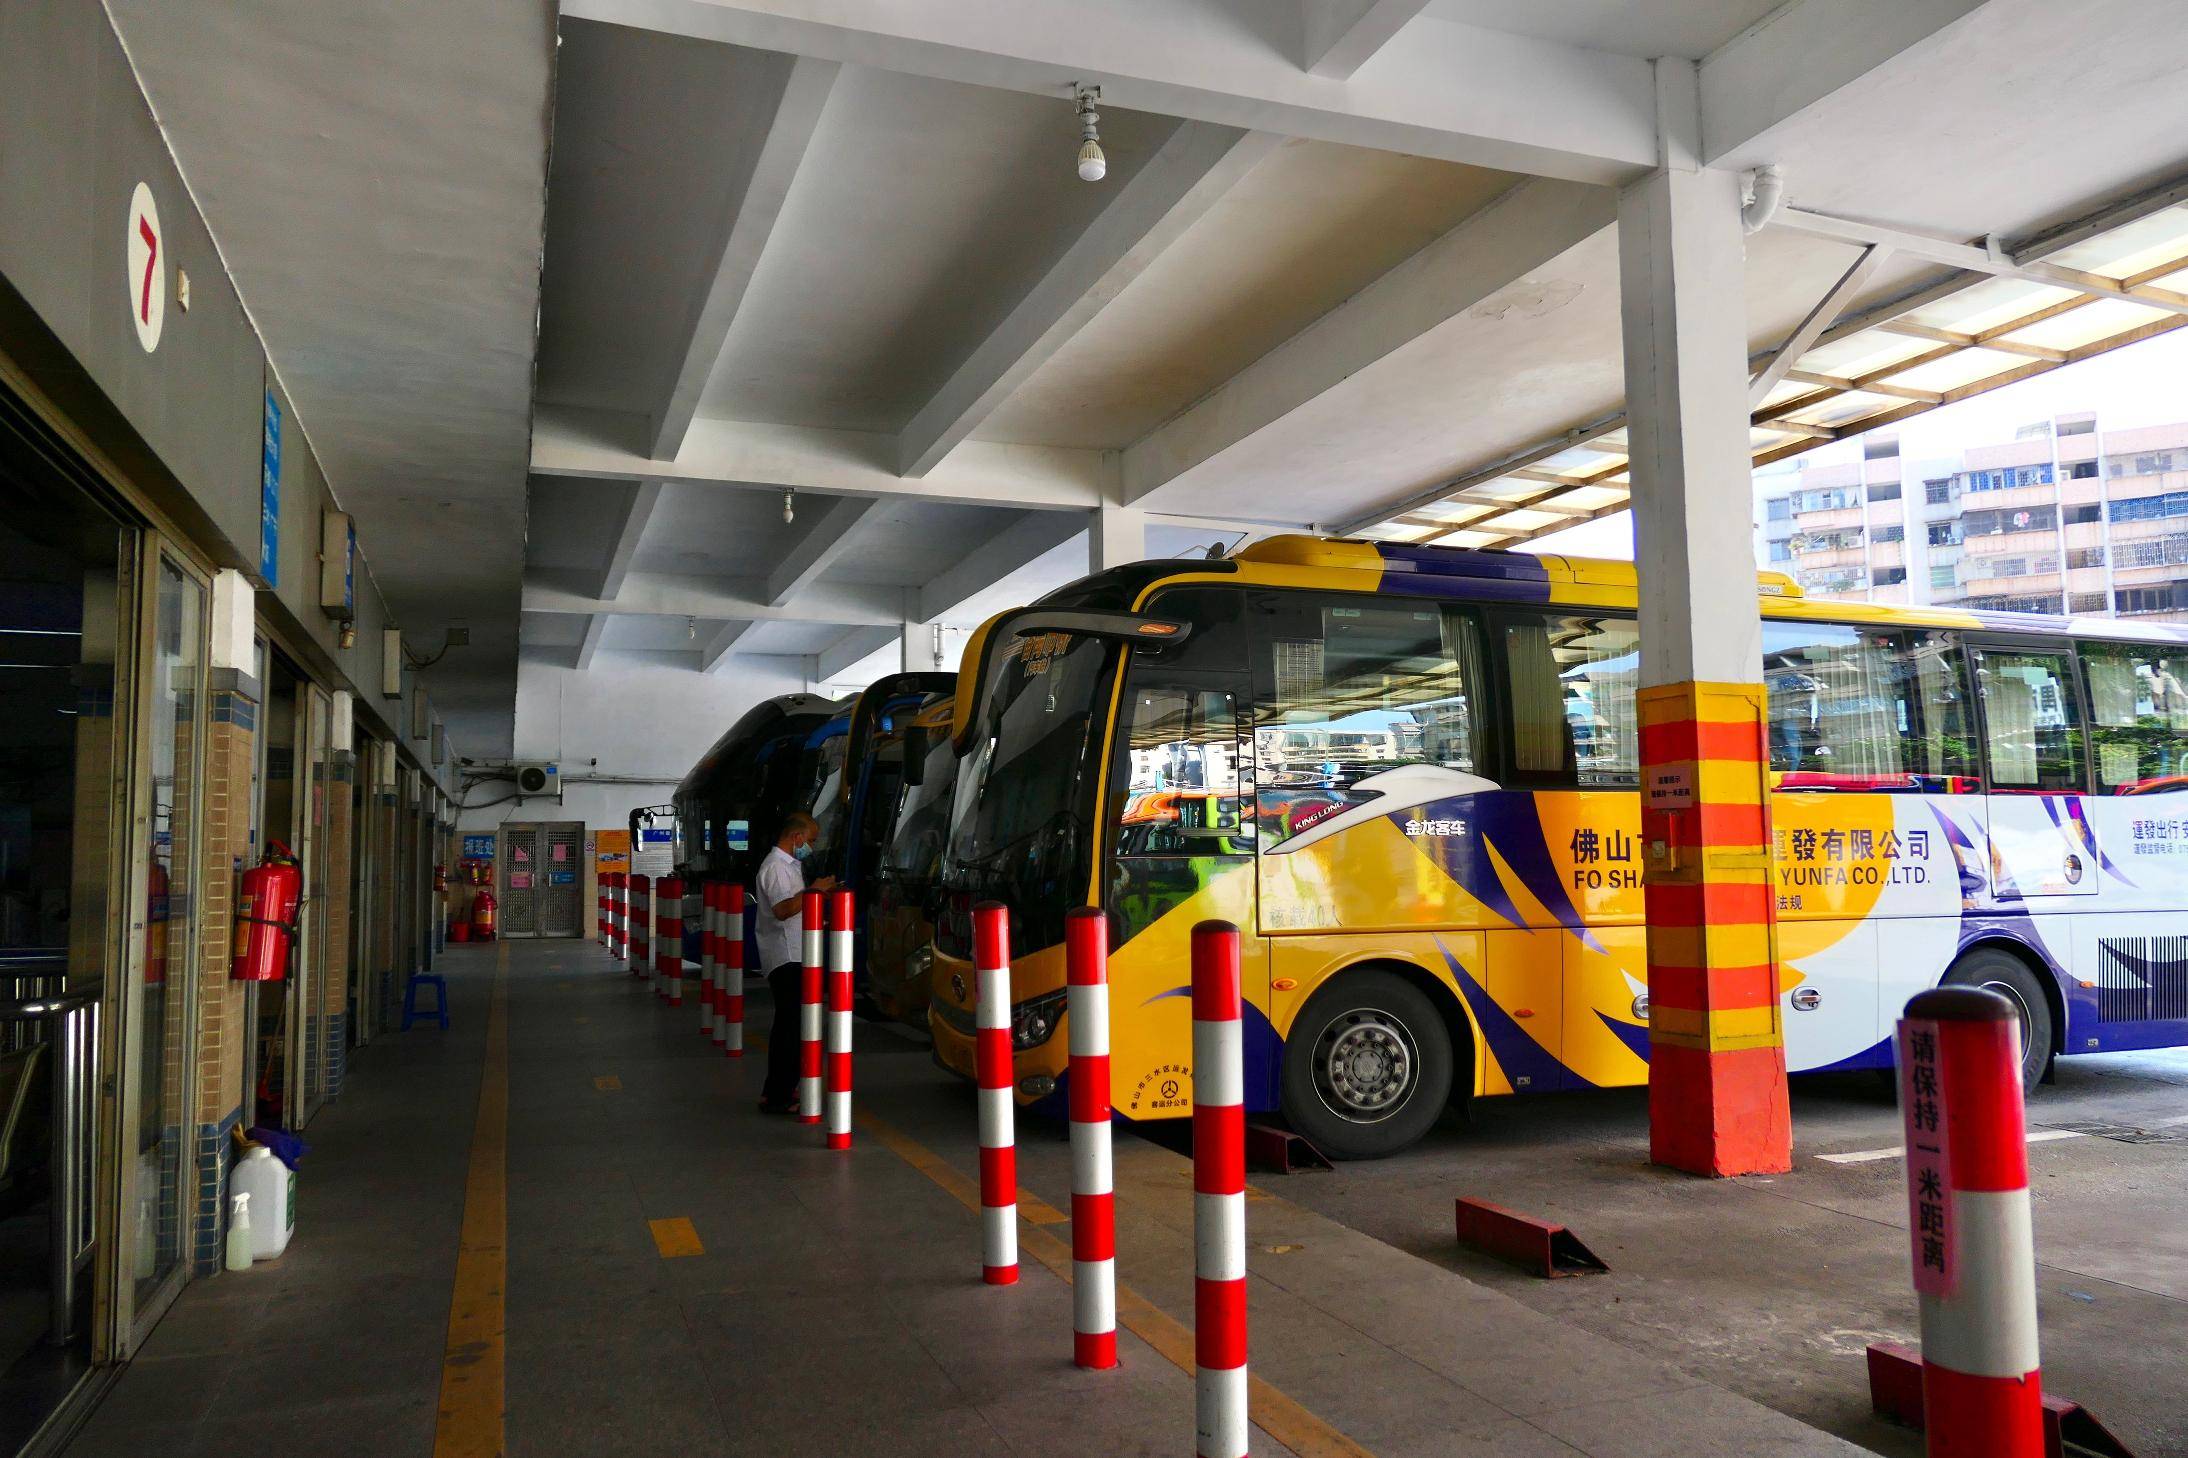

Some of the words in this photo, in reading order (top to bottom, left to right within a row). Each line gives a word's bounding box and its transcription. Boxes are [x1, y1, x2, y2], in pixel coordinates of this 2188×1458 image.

[140, 213, 157, 326] 7
[1295, 813, 1318, 830] KING
[1318, 801, 1344, 818] LONG
[1405, 820, 1466, 837] 金龙客车
[2133, 819, 2178, 839] 運發出行
[1574, 869, 1602, 890] FO
[1608, 869, 1645, 889] SH
[1781, 867, 1848, 886] YUNFA
[1852, 866, 1931, 887] CO.,LTD.
[1911, 1030, 1945, 1274] 请保持一米距离
